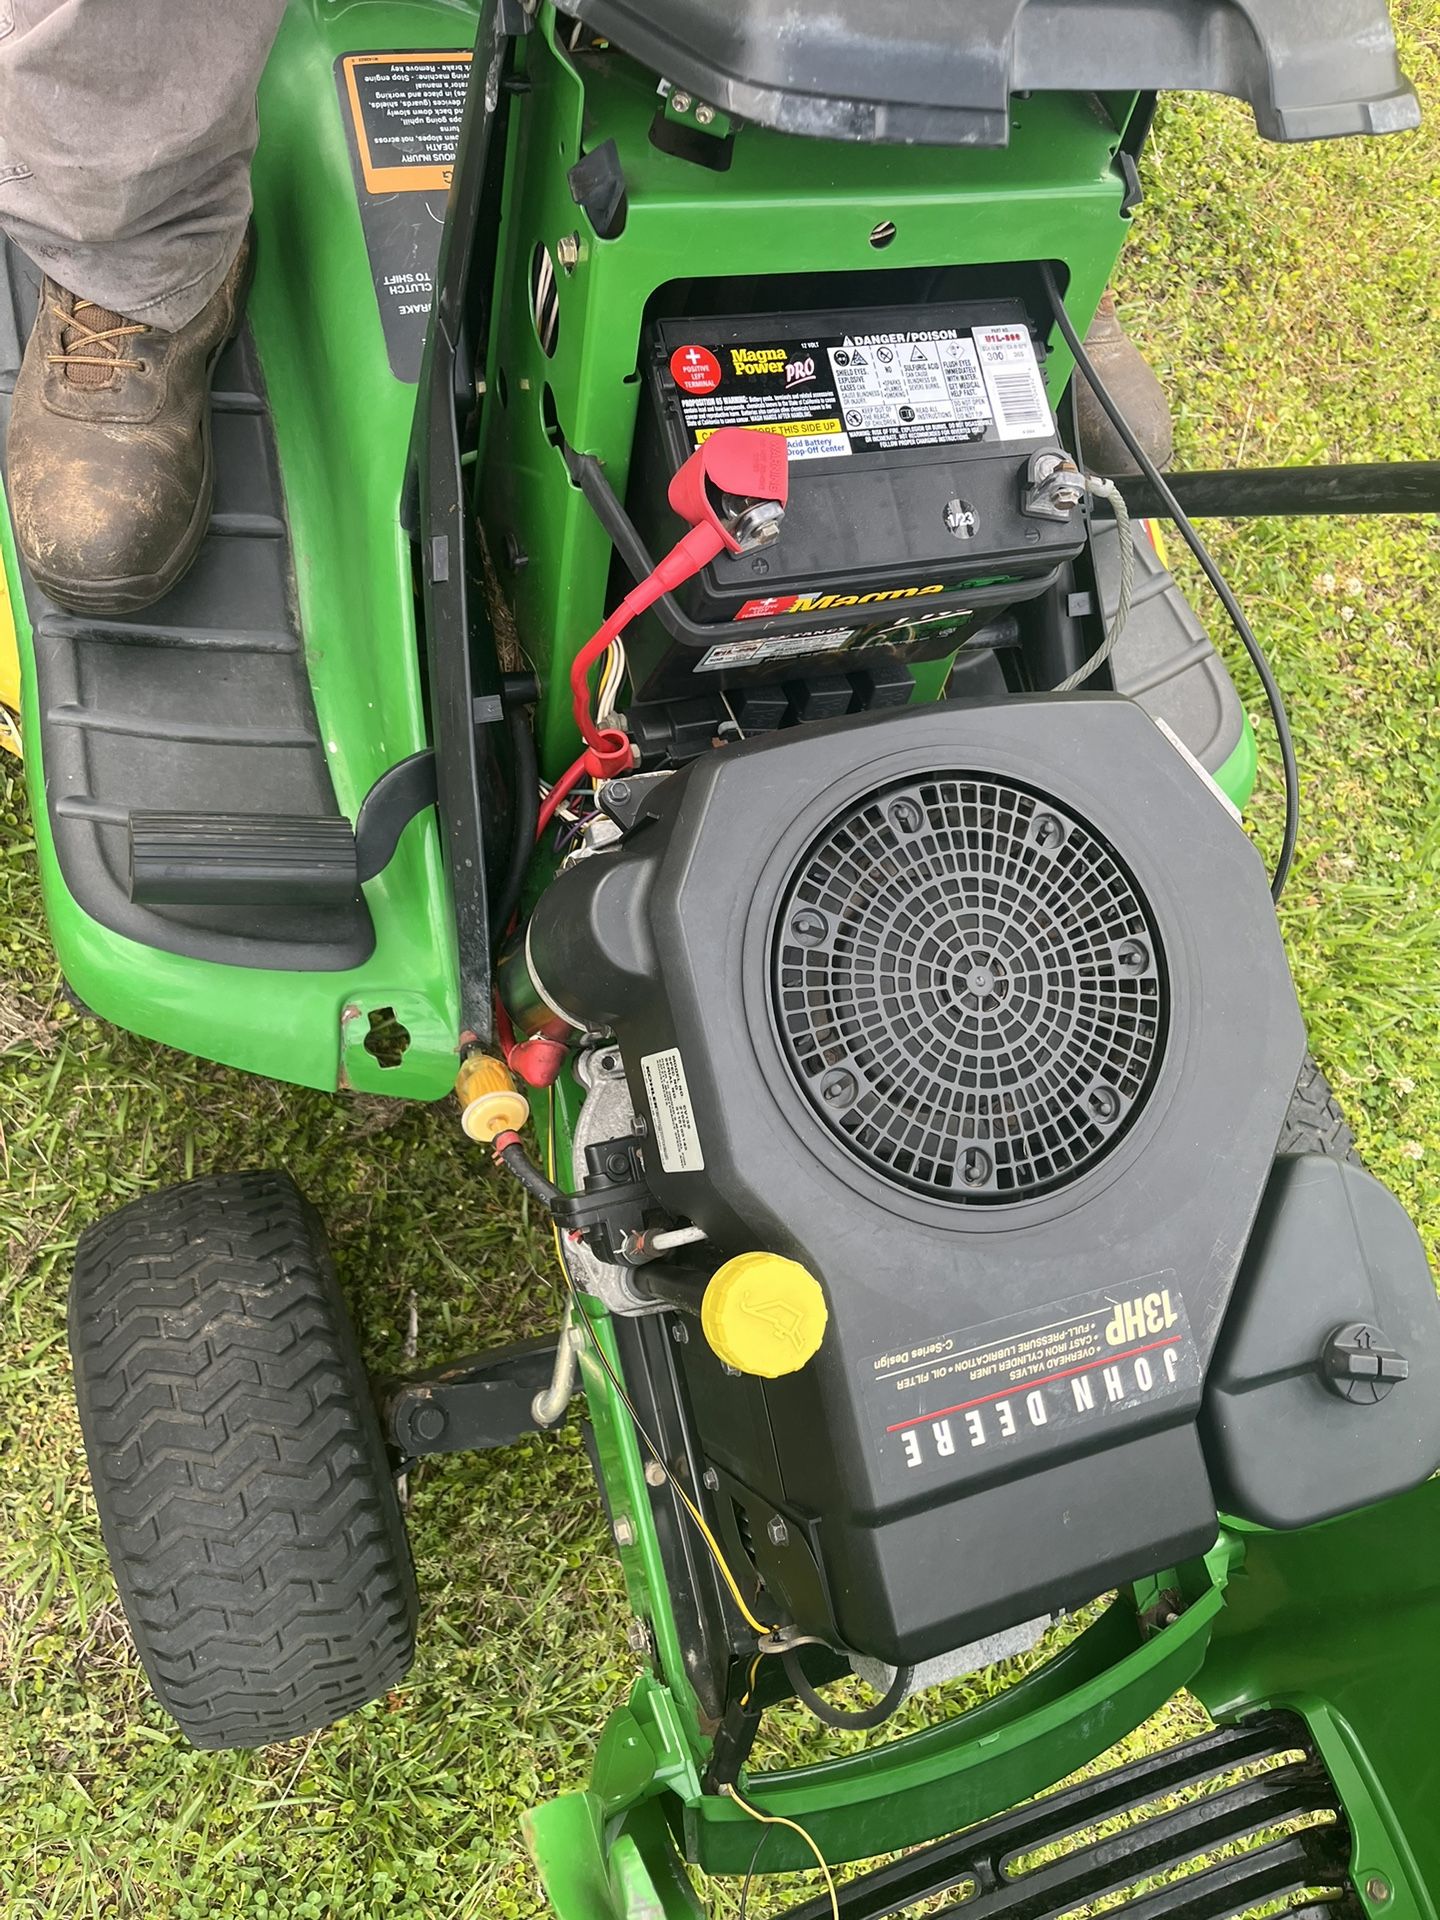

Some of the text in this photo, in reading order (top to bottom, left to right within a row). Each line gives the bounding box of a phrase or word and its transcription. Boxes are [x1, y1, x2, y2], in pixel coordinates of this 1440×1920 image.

[390, 64, 403, 72] key
[405, 65, 435, 73] Remove
[391, 73, 409, 81] Stop
[375, 90, 405, 99] working
[423, 89, 443, 97] place
[399, 99, 431, 107] (guards,
[386, 108, 410, 116] slowly
[400, 117, 424, 125] uphill,
[415, 133, 442, 142] slopes,
[425, 143, 453, 151] DEATH
[401, 153, 431, 162] INJURY
[383, 272, 430, 284] TO SHIFT
[389, 282, 432, 294] CLUTCH
[854, 329, 957, 345] DANGER/POISON
[730, 348, 787, 363] Magna
[986, 350, 1003, 361] 300
[682, 364, 709, 373] POSITIVE
[734, 357, 815, 382] Power PRO
[903, 362, 939, 372] SULFURIC ACID
[945, 366, 976, 375] IMMEDIATELY
[690, 372, 704, 380] LEFT
[835, 368, 853, 377] SHIELD
[684, 379, 715, 388] TERMINAL
[837, 375, 864, 384] EXPLOSIVE
[959, 380, 980, 389] MEDICAL
[778, 425, 799, 434] THIS
[800, 423, 820, 432] SIDE
[823, 421, 835, 430] UP
[787, 438, 832, 448] Acid Battery
[820, 444, 845, 453] Center
[947, 510, 974, 527] 1/23
[646, 1066, 657, 1108] KOHLER
[1098, 1288, 1179, 1347] 13HP
[871, 1338, 954, 1372] C-Series Design
[895, 1322, 1090, 1390] FULL-PRESSURE LUBRICATION OIL FILTER
[968, 1334, 1093, 1380] CAST IRON CYLINDER LINER
[1008, 1345, 1096, 1380] OVERHEAD VALVES
[898, 1346, 1183, 1467] JOHN DEERE
